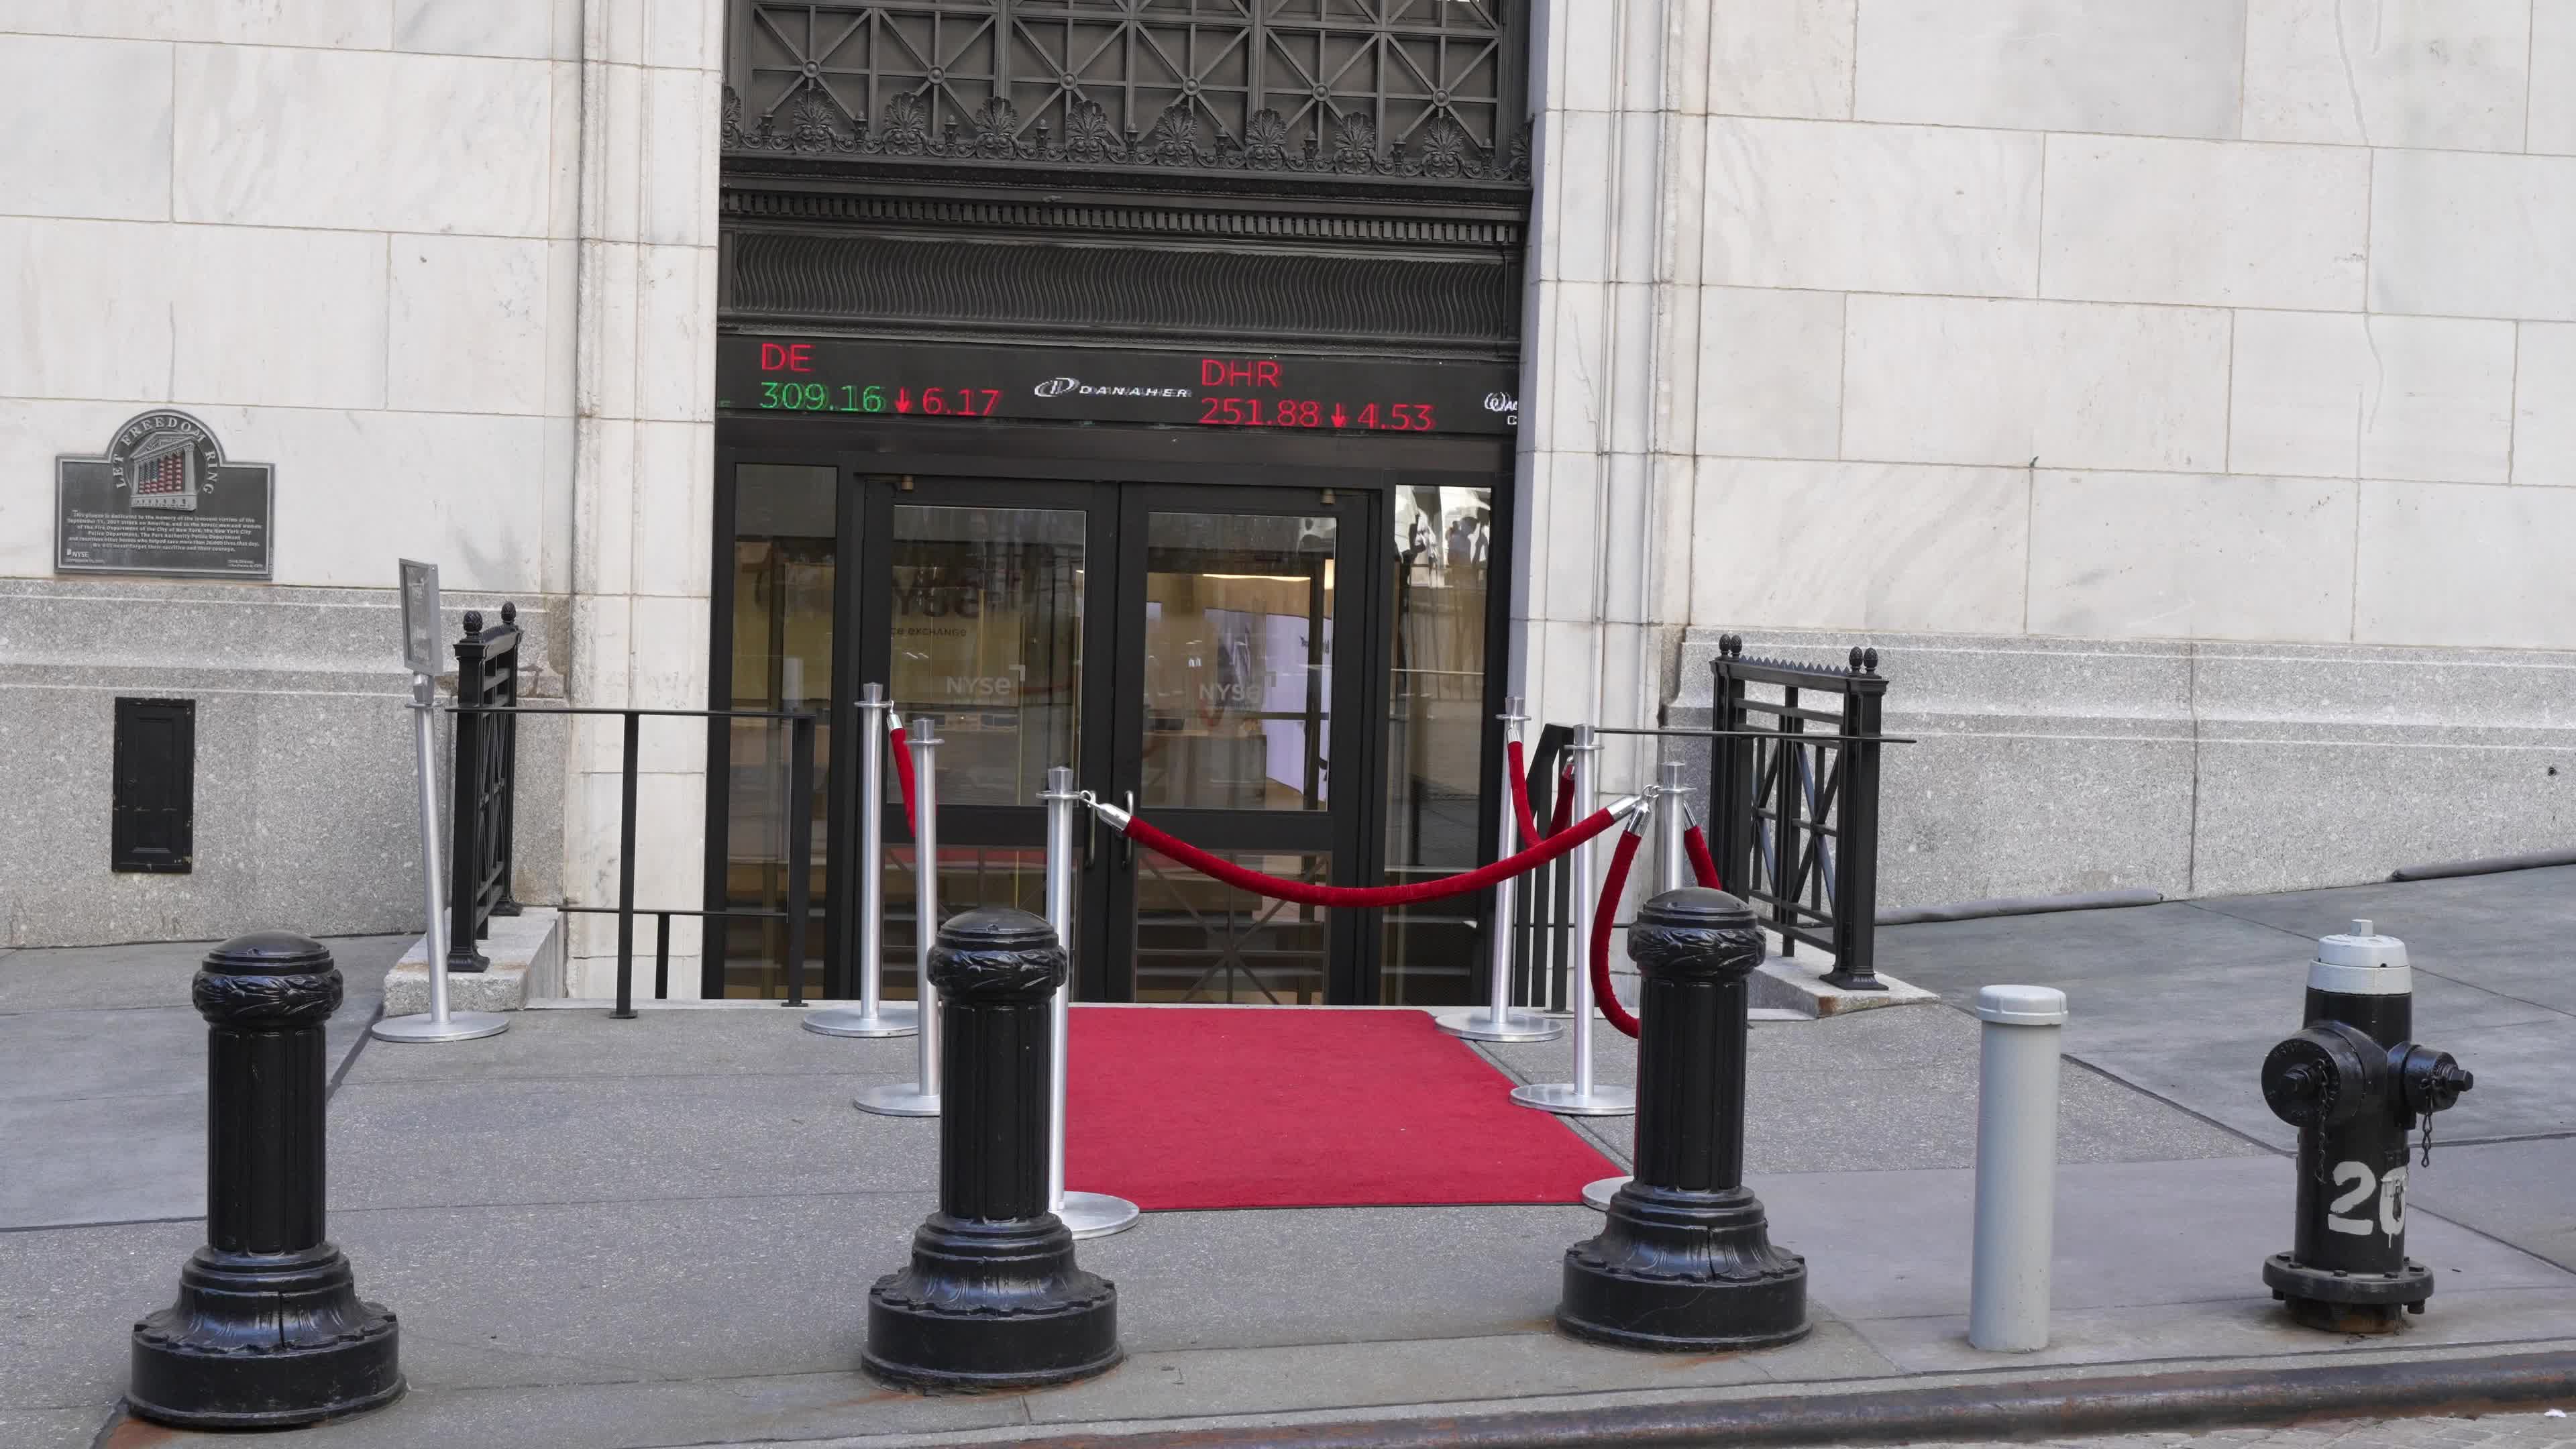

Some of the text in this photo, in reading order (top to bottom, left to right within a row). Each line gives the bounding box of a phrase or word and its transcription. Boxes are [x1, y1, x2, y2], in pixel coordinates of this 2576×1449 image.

[761, 343, 814, 372] DE
[1201, 359, 1282, 388] DHR
[759, 382, 1002, 416] 309.16 6.17
[1079, 385, 1192, 398] DANAHER
[1199, 398, 1435, 431] 251.88 4.53
[113, 417, 218, 494] LET FREEDOM RING
[2328, 1161, 2409, 1238] 20
